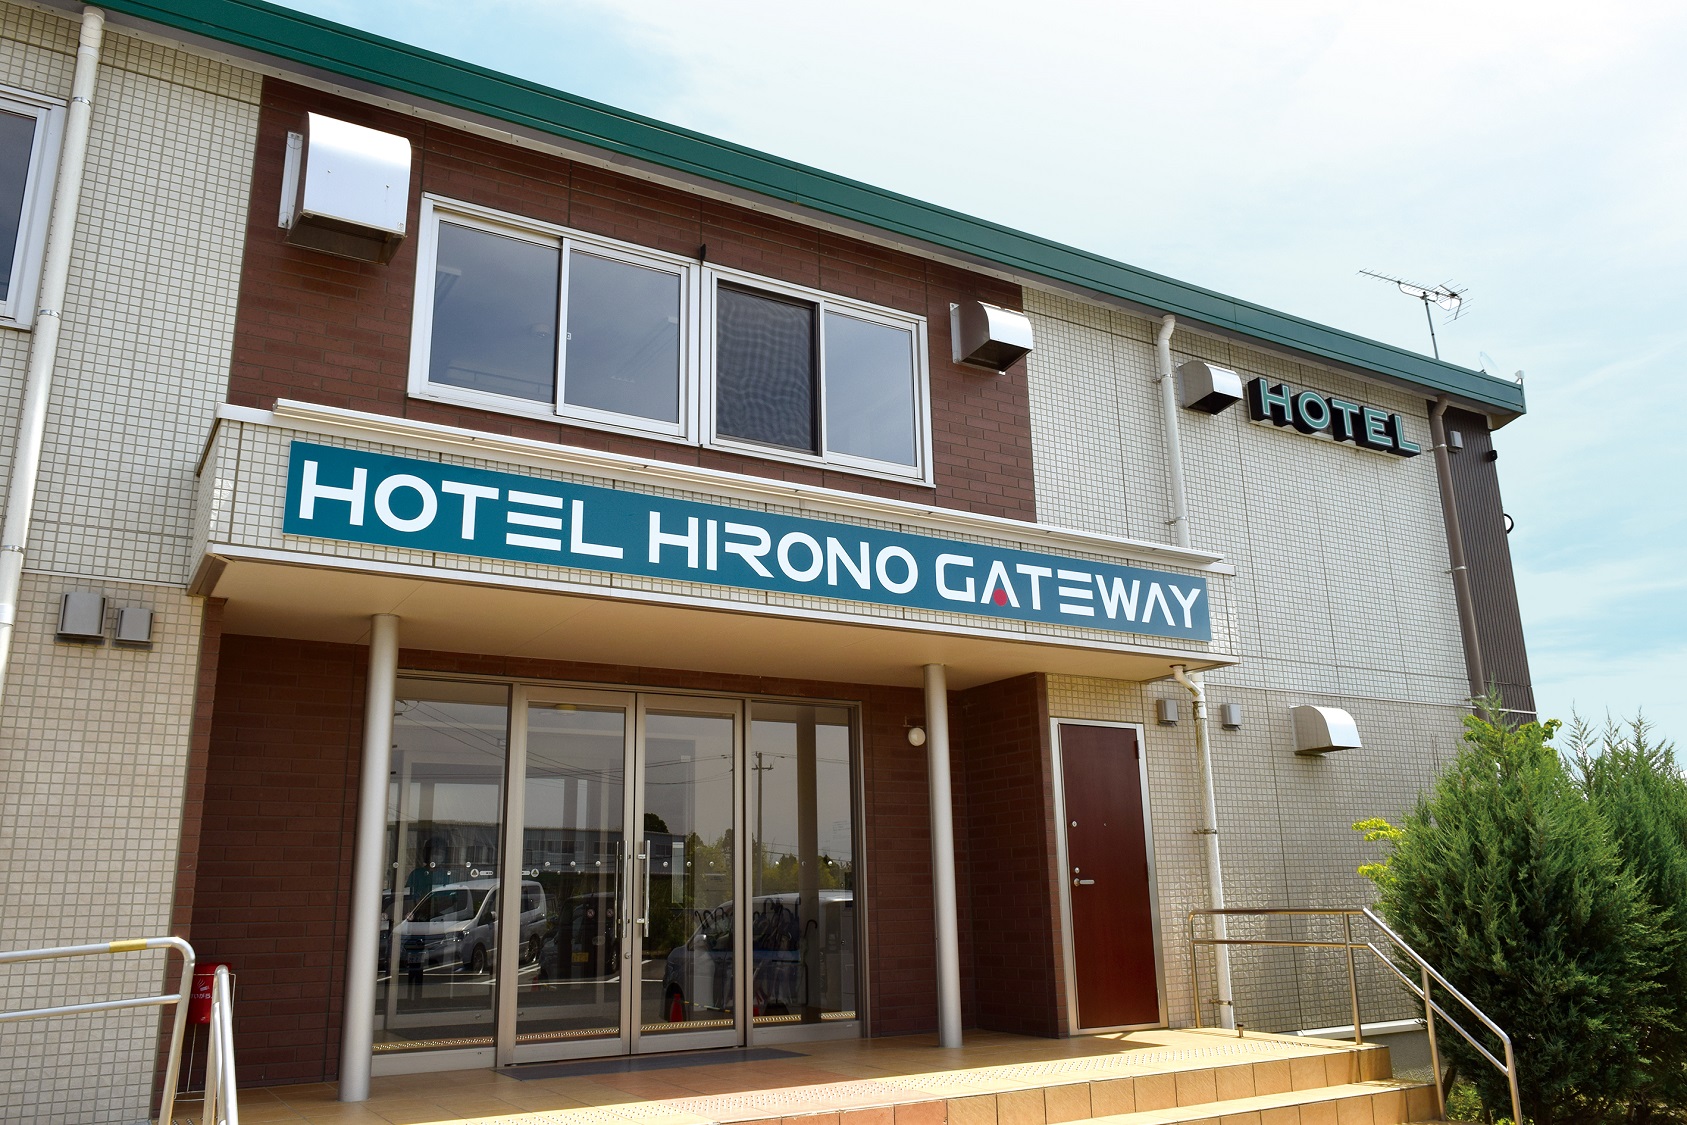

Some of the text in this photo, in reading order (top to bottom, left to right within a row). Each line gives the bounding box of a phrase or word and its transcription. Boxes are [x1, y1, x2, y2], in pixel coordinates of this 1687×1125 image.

[1257, 377, 1421, 455] HOTEL
[298, 459, 1201, 628] HOTEL HIRONO GATEWAY
